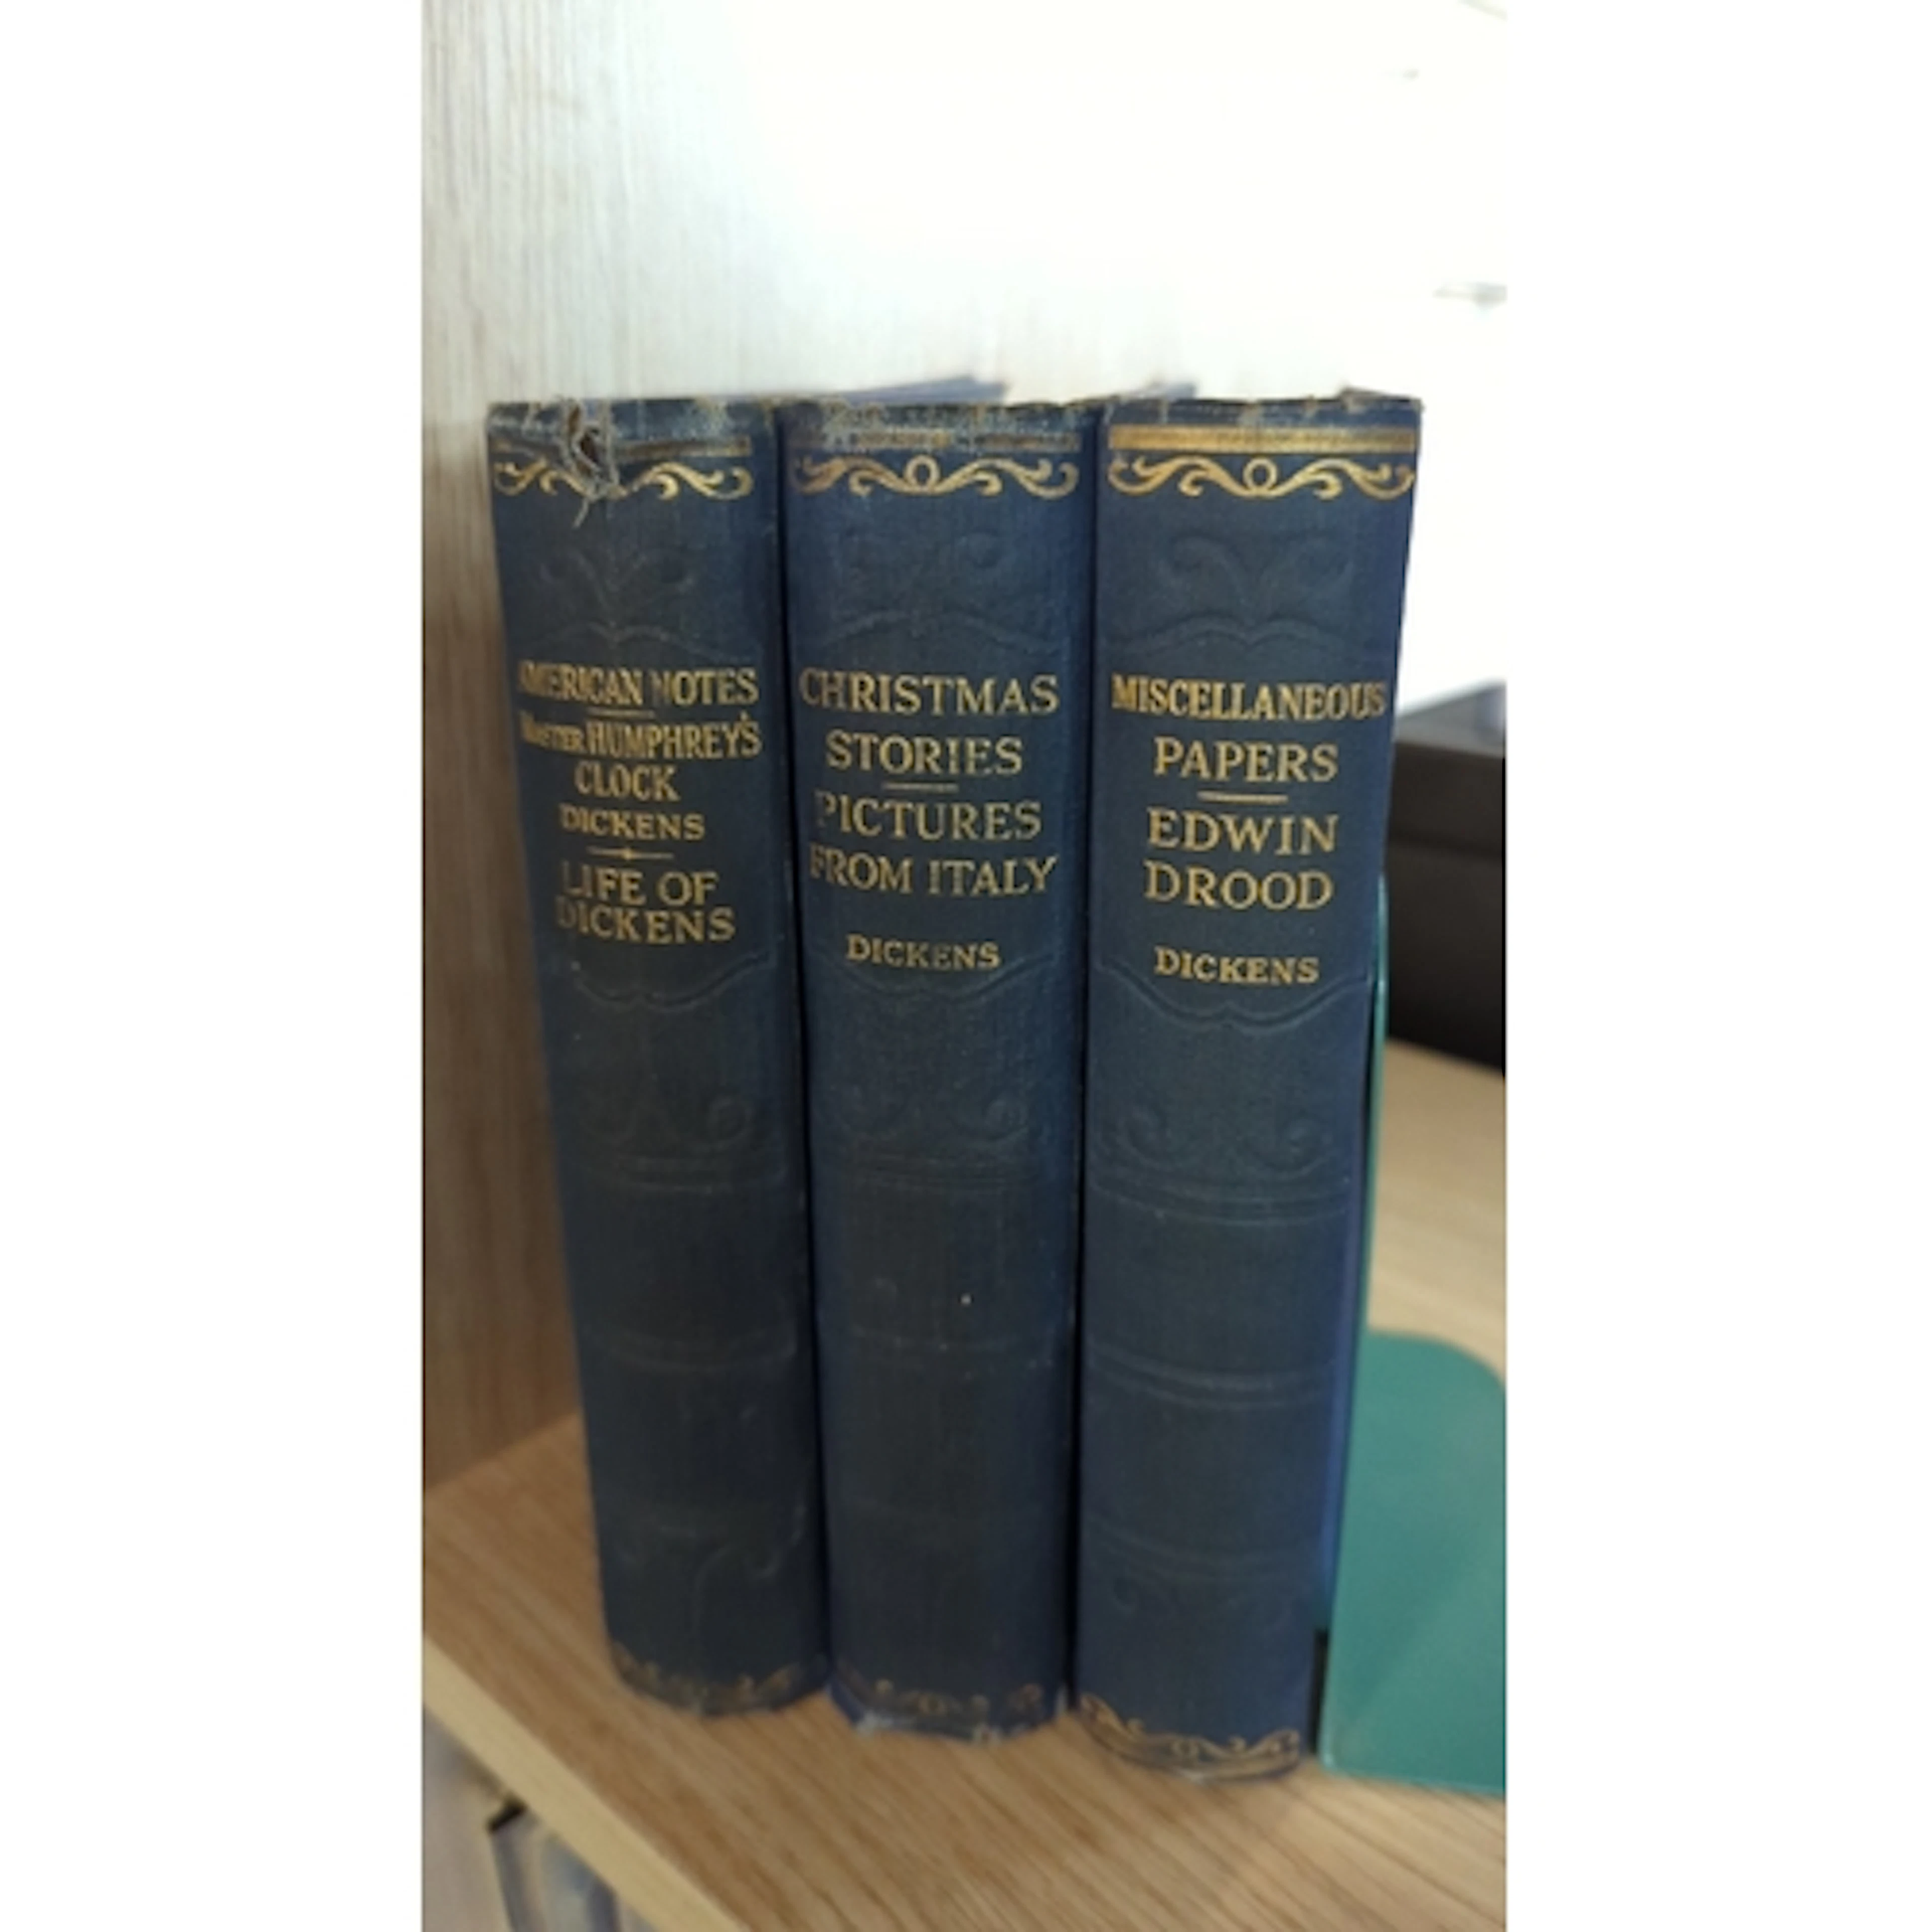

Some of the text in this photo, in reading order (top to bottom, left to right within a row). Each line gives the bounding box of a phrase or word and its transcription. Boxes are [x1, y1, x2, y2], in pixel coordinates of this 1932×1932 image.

[650, 667, 759, 705] NOTES
[799, 667, 1060, 716] CHRISTMAS
[1111, 673, 1387, 721] MISCELLANEOUS
[826, 729, 1023, 776] STORIES
[1154, 736, 1338, 783] PAPERS
[574, 761, 681, 801] CLOCK
[559, 803, 705, 841] DICKENS
[814, 789, 1042, 841] PICTURES
[1147, 806, 1339, 855] EDWIN
[560, 860, 719, 906] LIFE OF
[809, 842, 1059, 897] FROM ITALY
[1143, 859, 1335, 911] DROOD
[555, 895, 736, 944] DICKENS
[846, 933, 1002, 972] DICKENS
[1154, 945, 1320, 985] DICKENS
